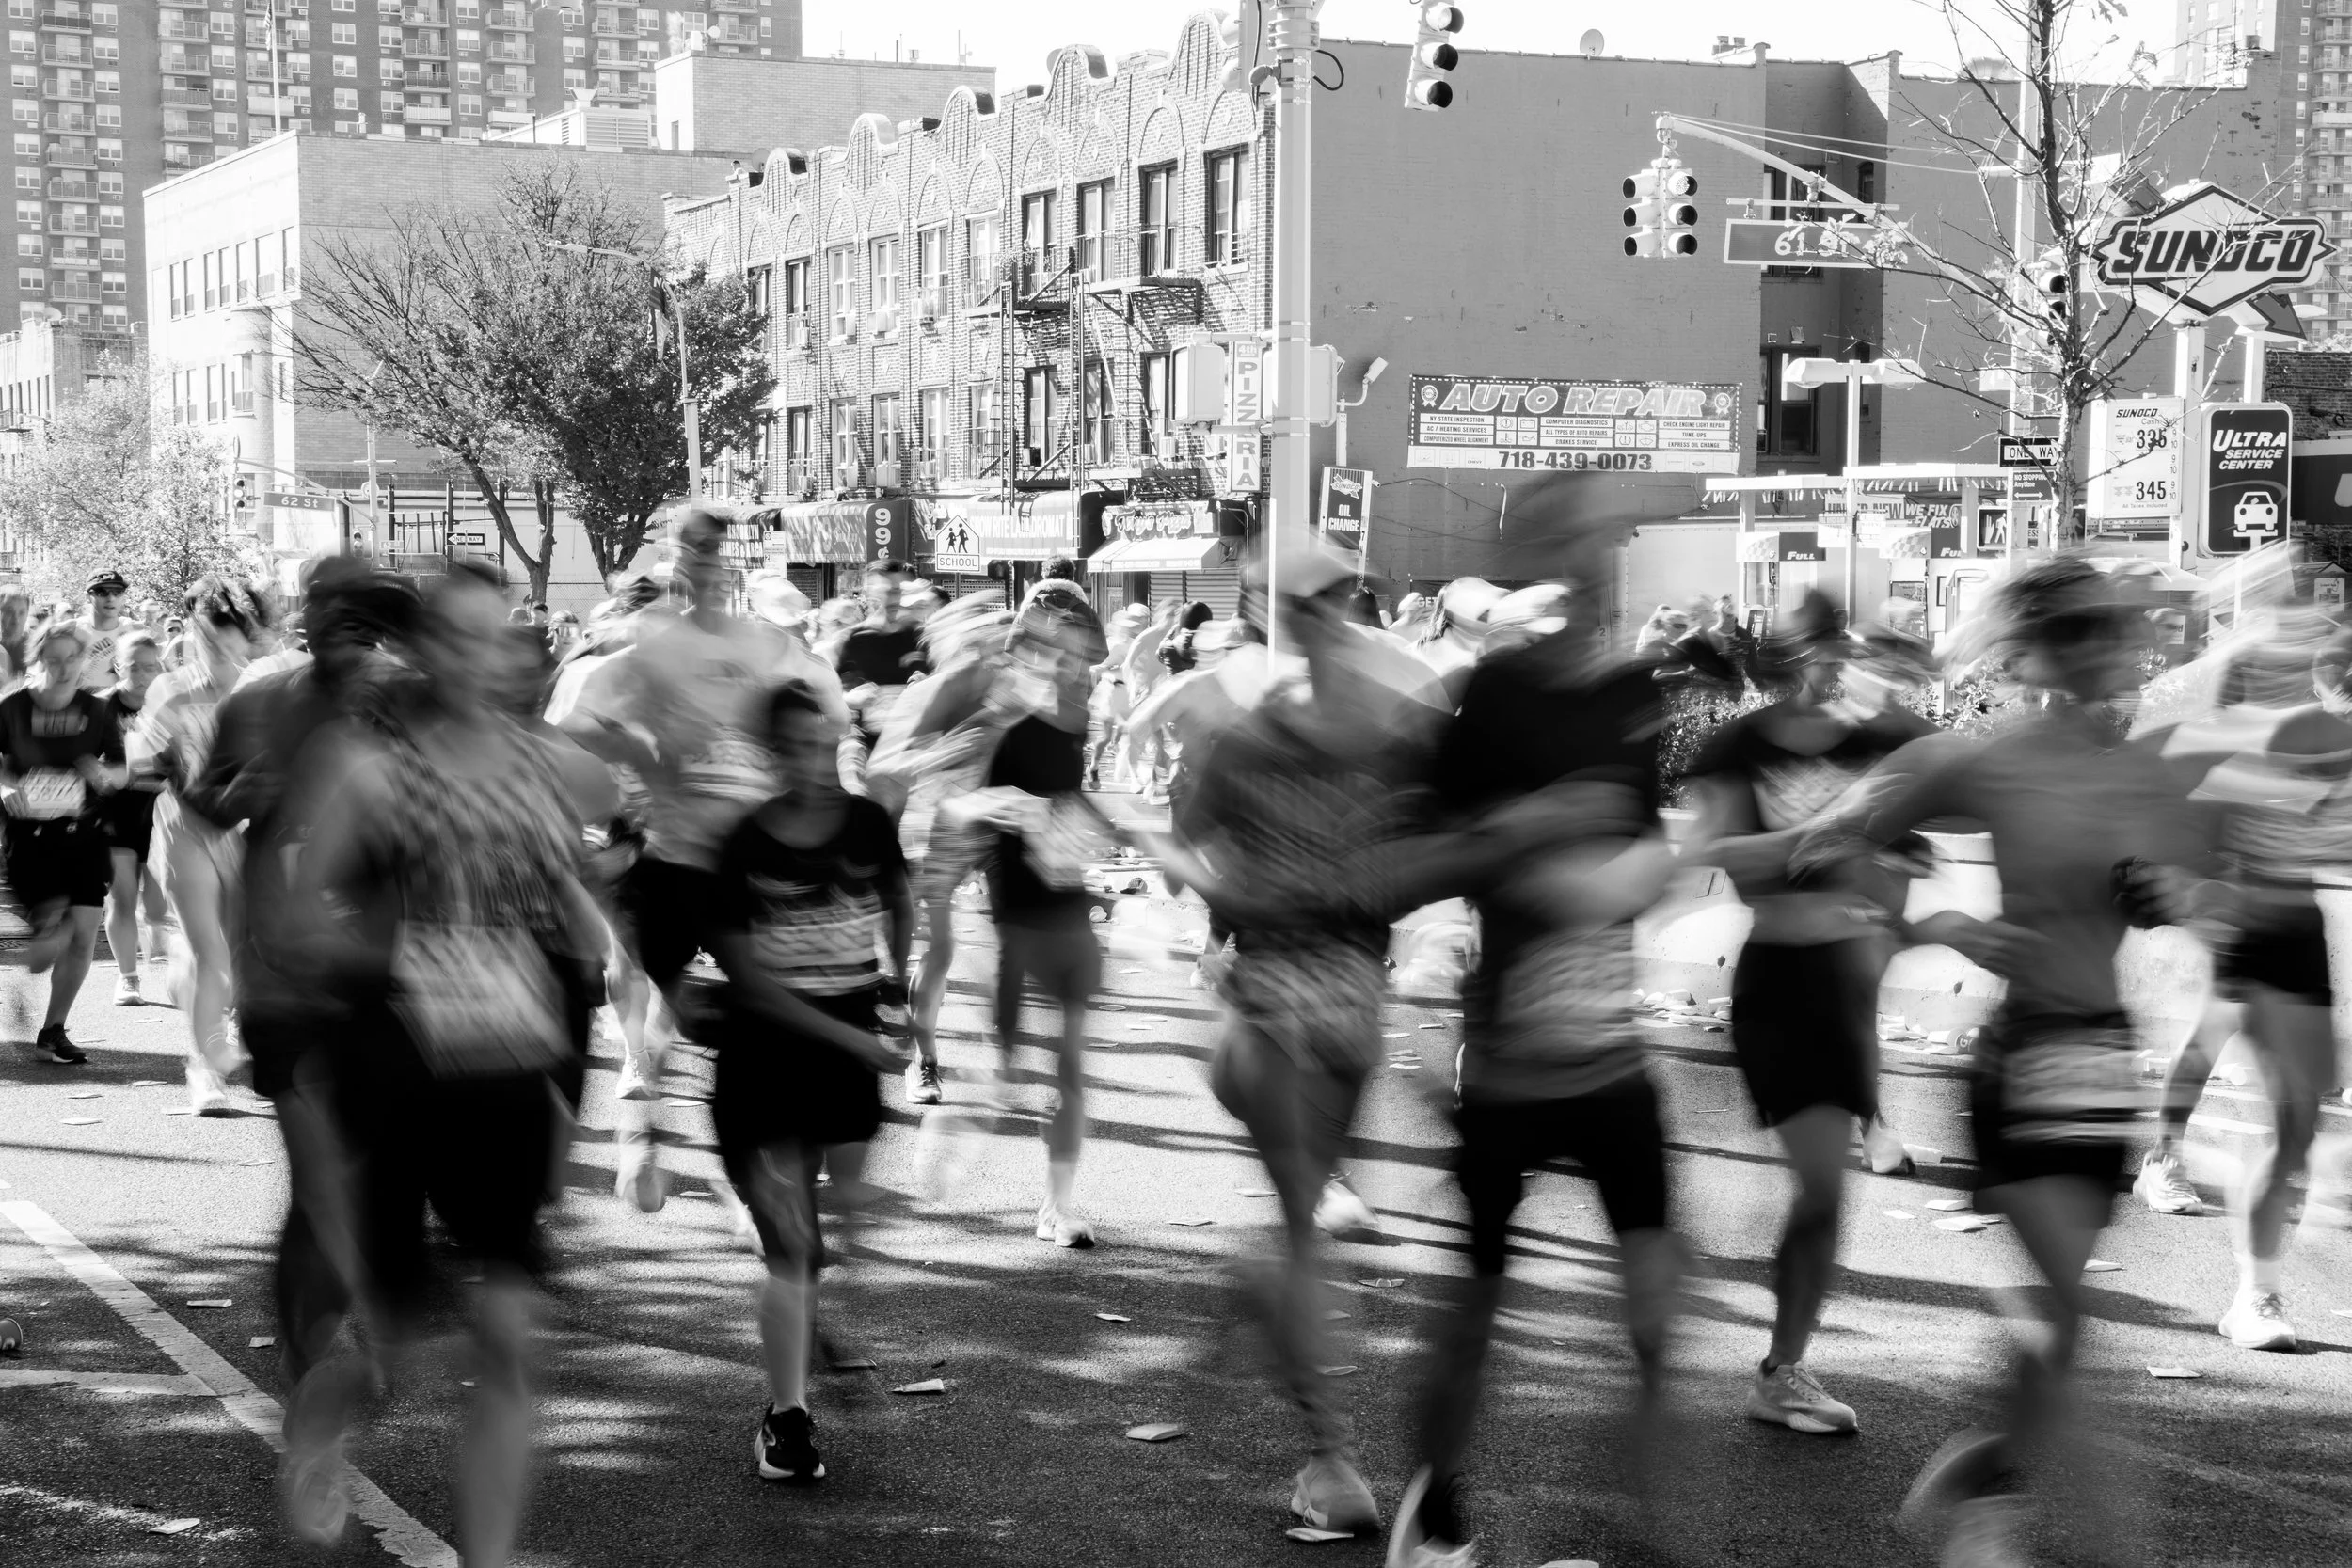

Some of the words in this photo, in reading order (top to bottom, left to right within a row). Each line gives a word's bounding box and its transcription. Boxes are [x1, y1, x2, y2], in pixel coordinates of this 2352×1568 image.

[1774, 231, 1805, 256] 61
[2111, 230, 2316, 273] SUNOCO
[1438, 383, 1558, 413] AUTO
[1563, 387, 1707, 417] REPAIR
[2115, 408, 2158, 419] SUNOCO
[1235, 361, 1258, 486] PIZZRIA
[2212, 429, 2287, 452] ULTRA
[1498, 451, 1652, 470] 718-439-0073
[2224, 449, 2284, 459] SERVICE
[2218, 460, 2274, 469] CENTER
[2136, 481, 2167, 500] 345
[281, 496, 298, 506] 62
[303, 498, 319, 508] St
[1338, 503, 1351, 516] OIL
[1905, 504, 1924, 516] WE
[1927, 504, 1948, 516] FIX
[1327, 517, 1360, 531] CHANGE
[939, 557, 977, 567] SCHOOL
